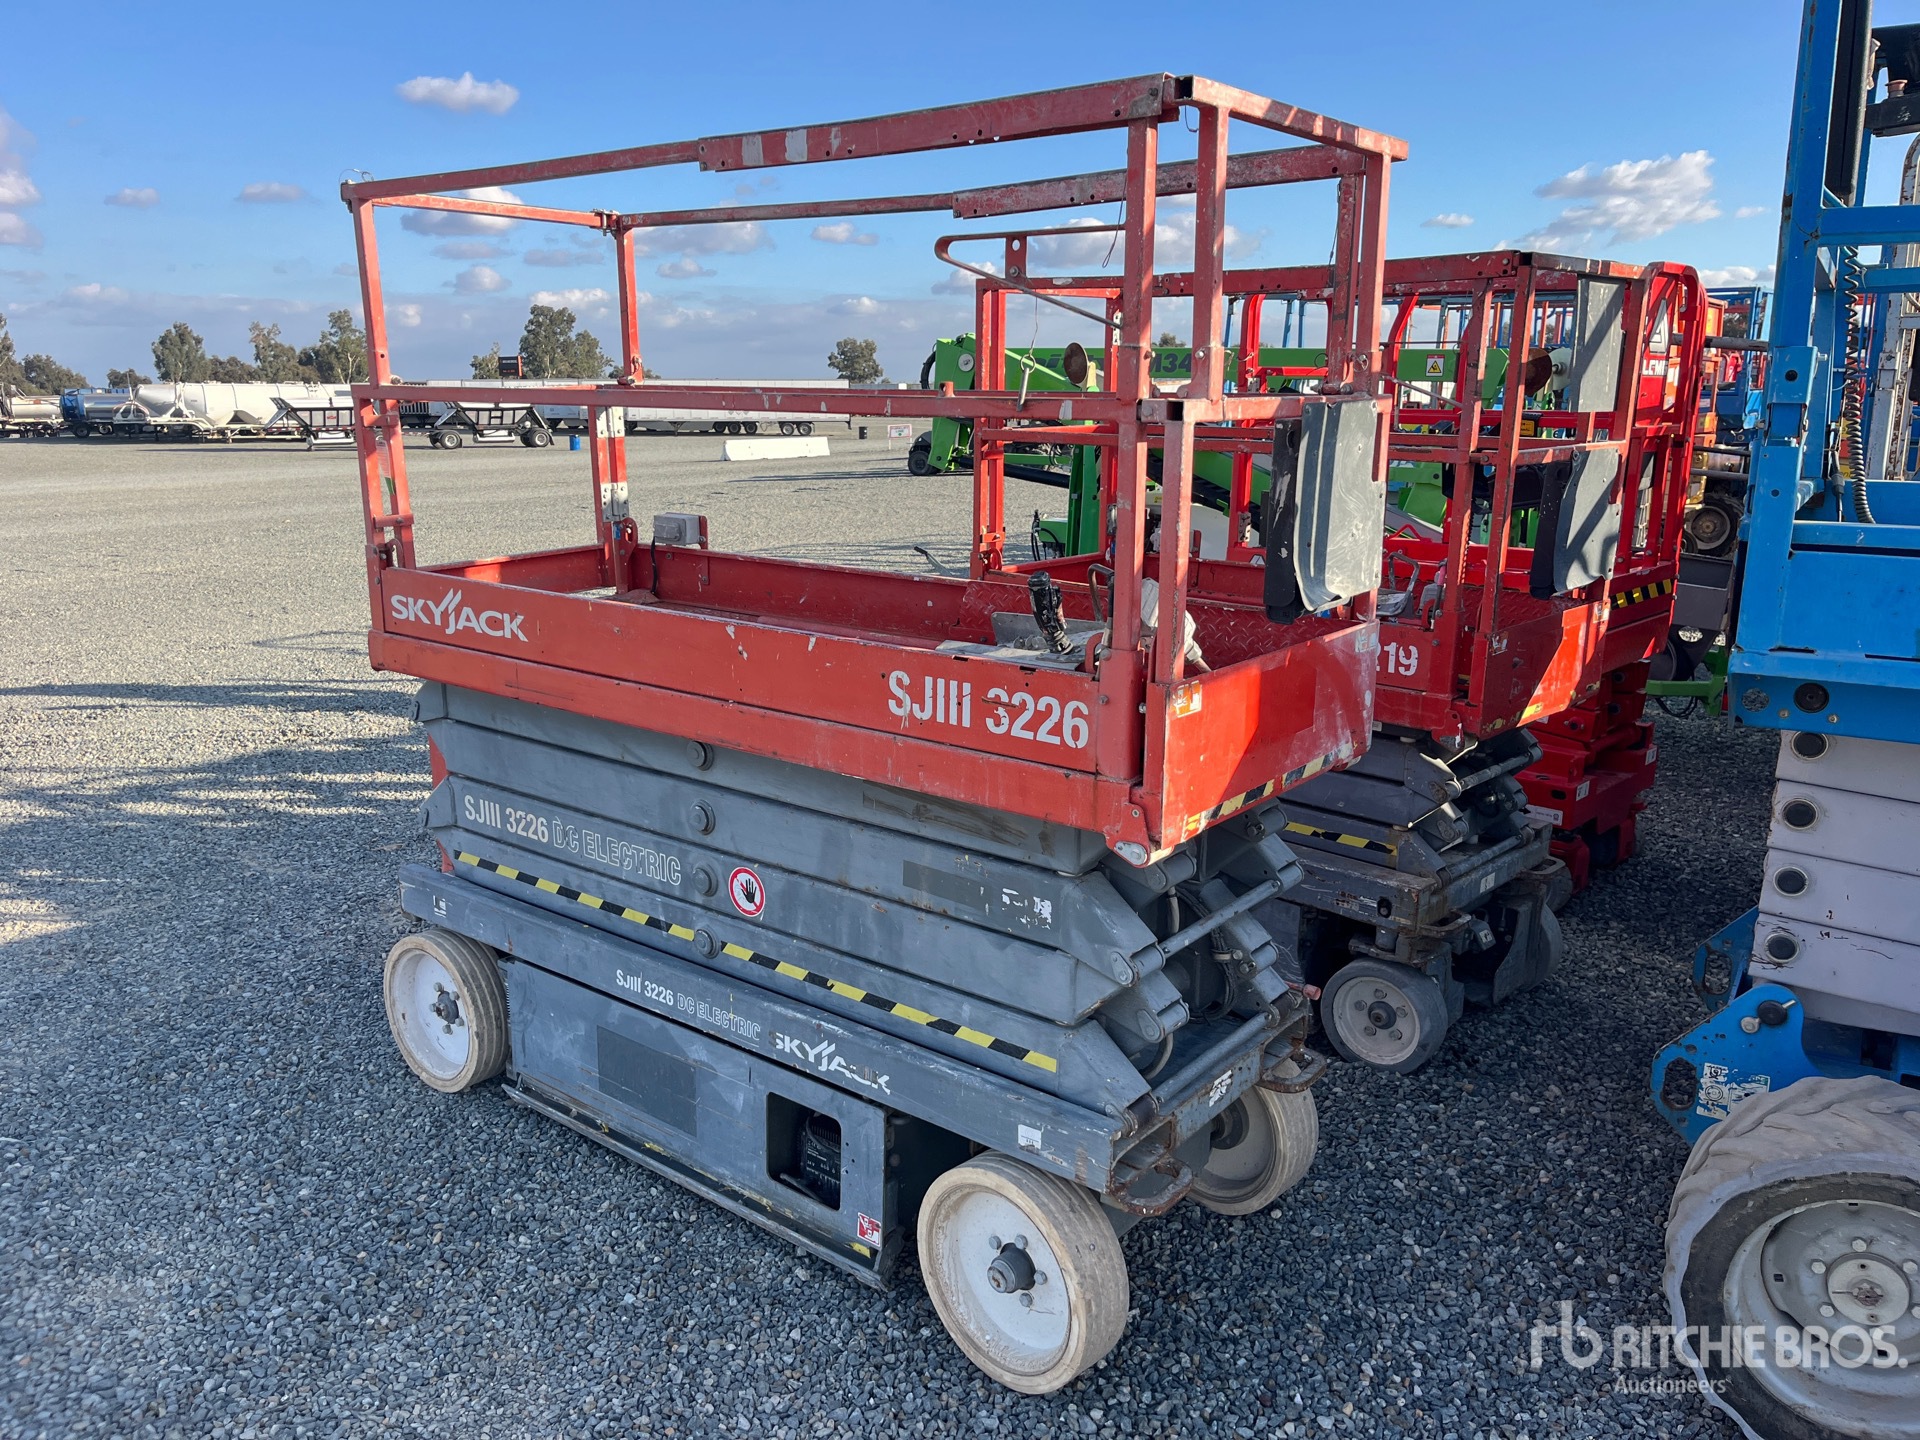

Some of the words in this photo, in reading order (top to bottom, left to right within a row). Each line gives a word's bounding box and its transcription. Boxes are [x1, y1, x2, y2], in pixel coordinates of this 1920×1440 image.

[391, 588, 528, 642] SKYJACK
[888, 670, 972, 728] SJIII
[985, 688, 1089, 749] 3226
[464, 794, 502, 828] SJIII
[505, 807, 549, 843] 3226
[552, 820, 580, 853] DC
[582, 829, 682, 886] ELECTRIC
[616, 969, 642, 993] SJIII
[644, 980, 674, 1006] 3226
[677, 992, 695, 1015] DC
[696, 1001, 761, 1041] ELECTRIC
